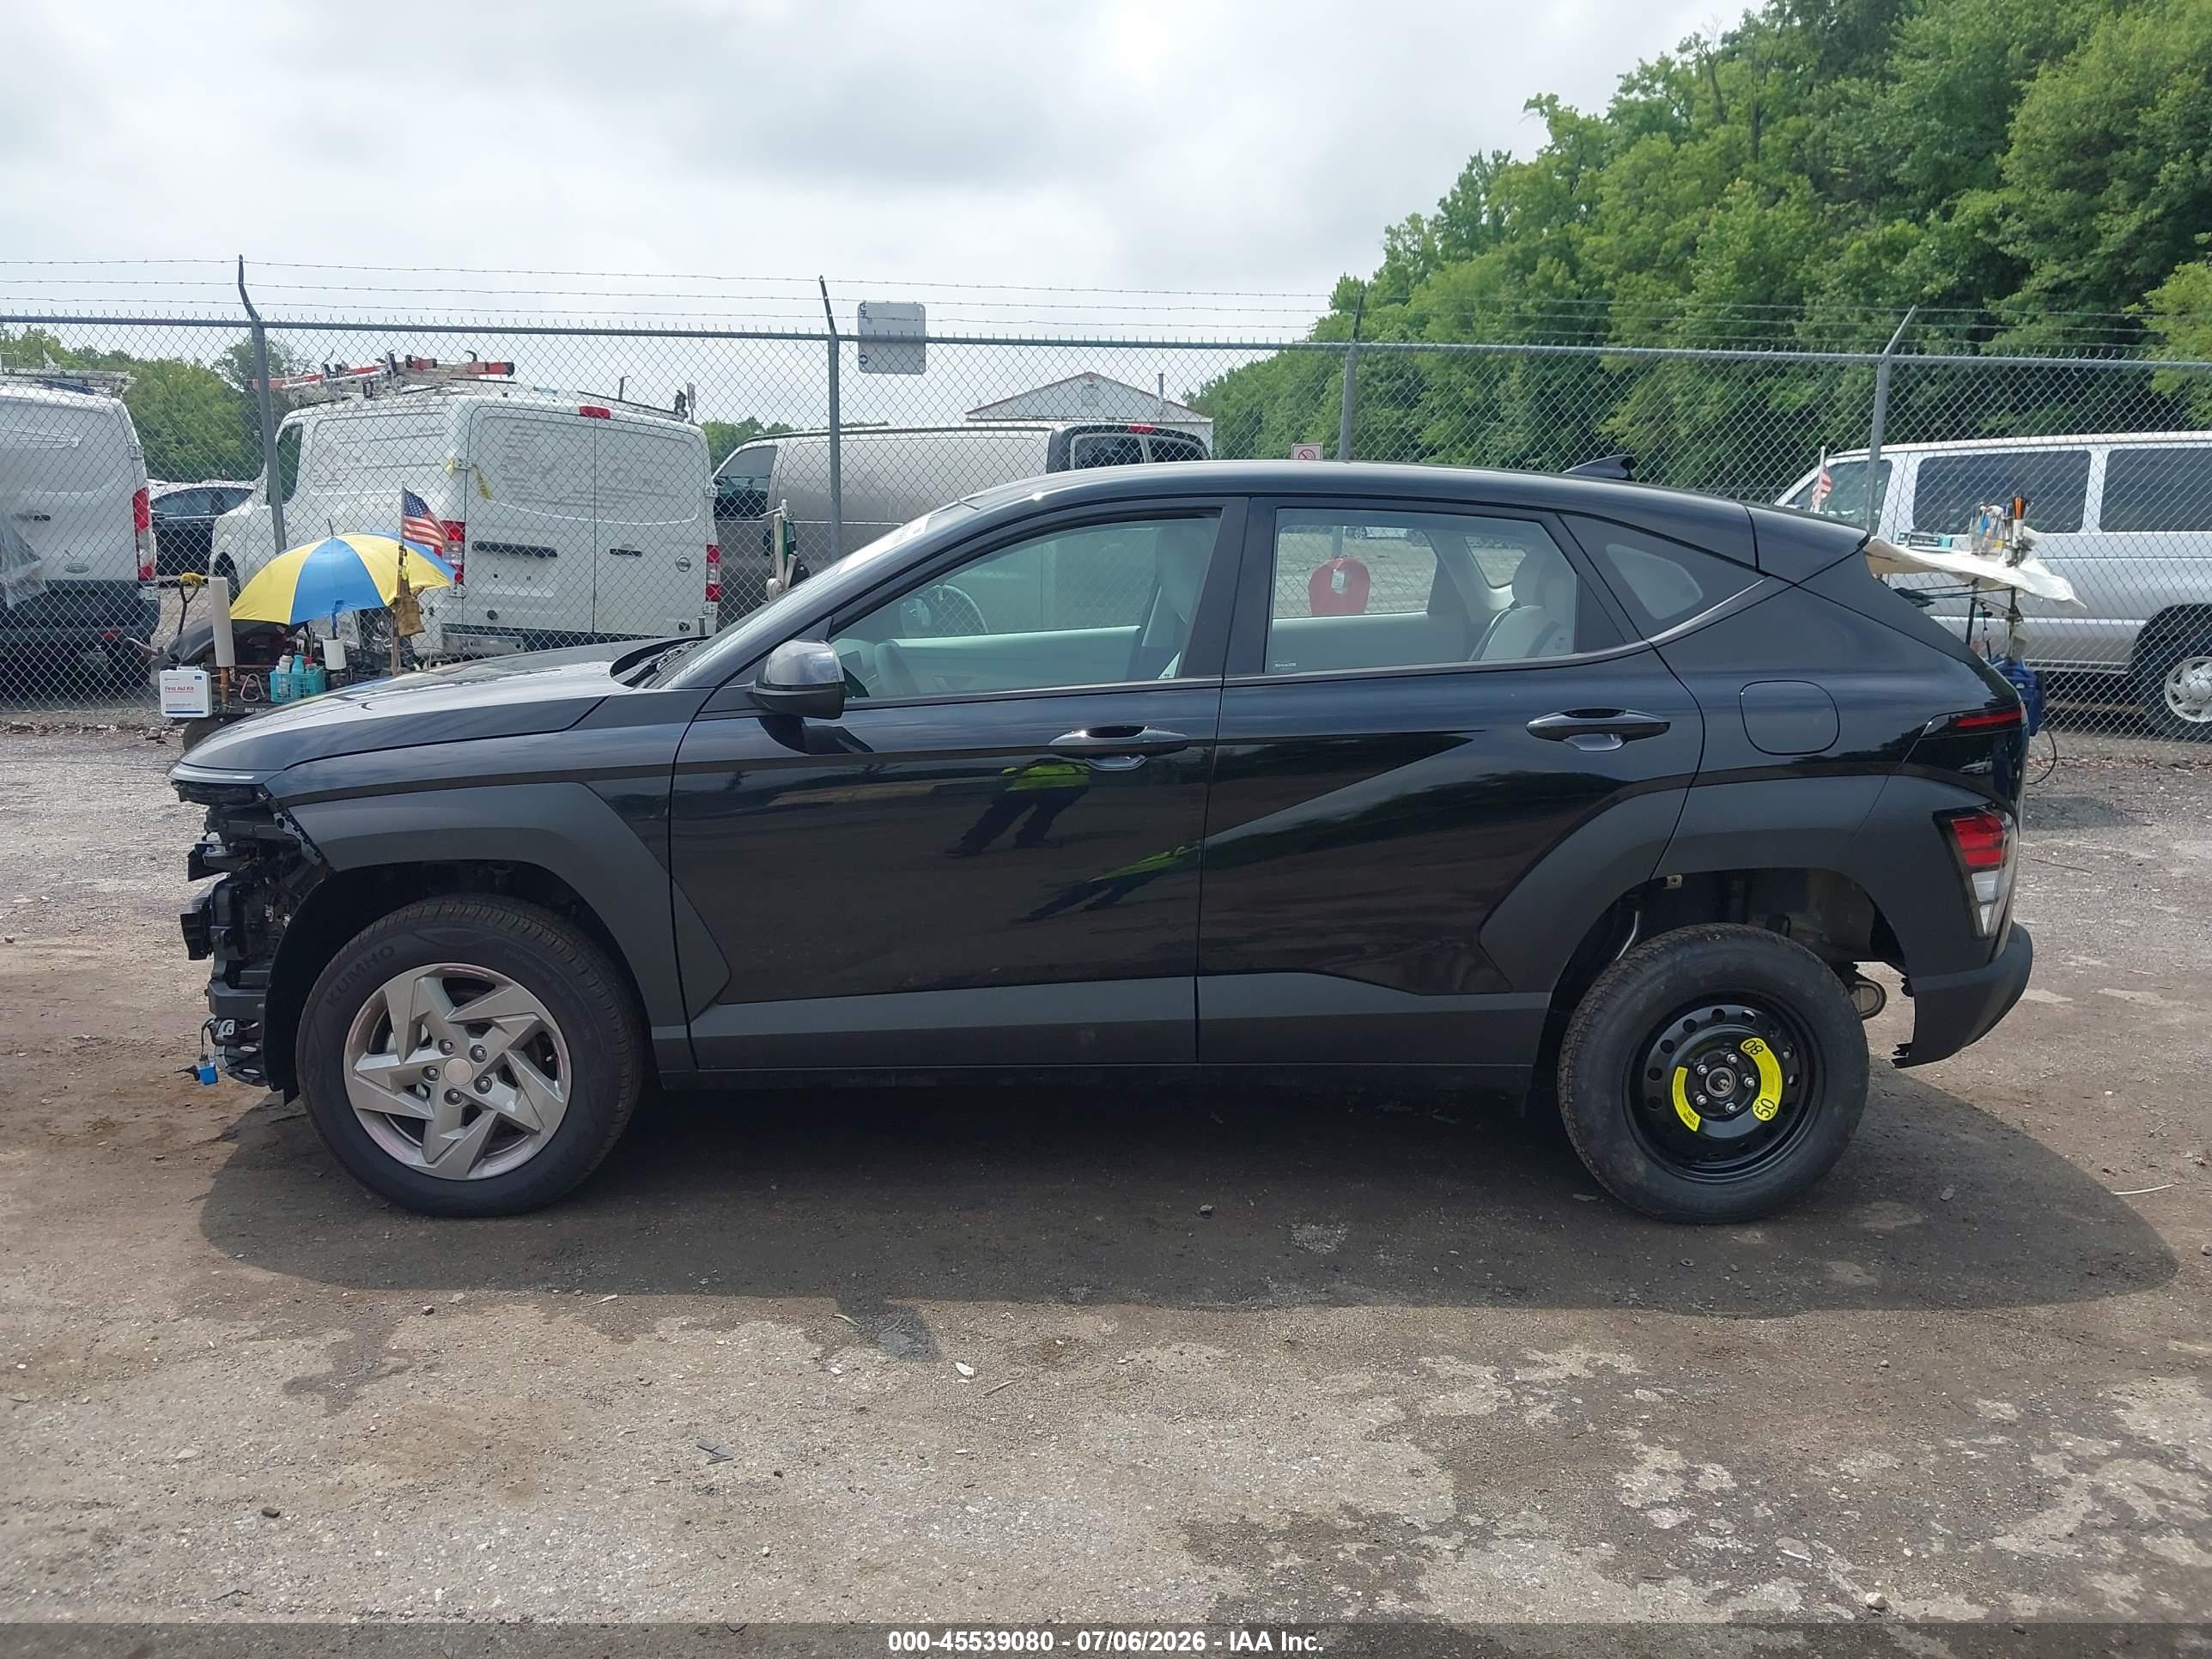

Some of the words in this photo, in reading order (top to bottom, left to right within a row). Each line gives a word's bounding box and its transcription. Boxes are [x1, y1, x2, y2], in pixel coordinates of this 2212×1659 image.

[325, 945, 395, 1007] KUMHO
[1743, 1040, 1764, 1055] 80
[1755, 1097, 1776, 1119] 50
